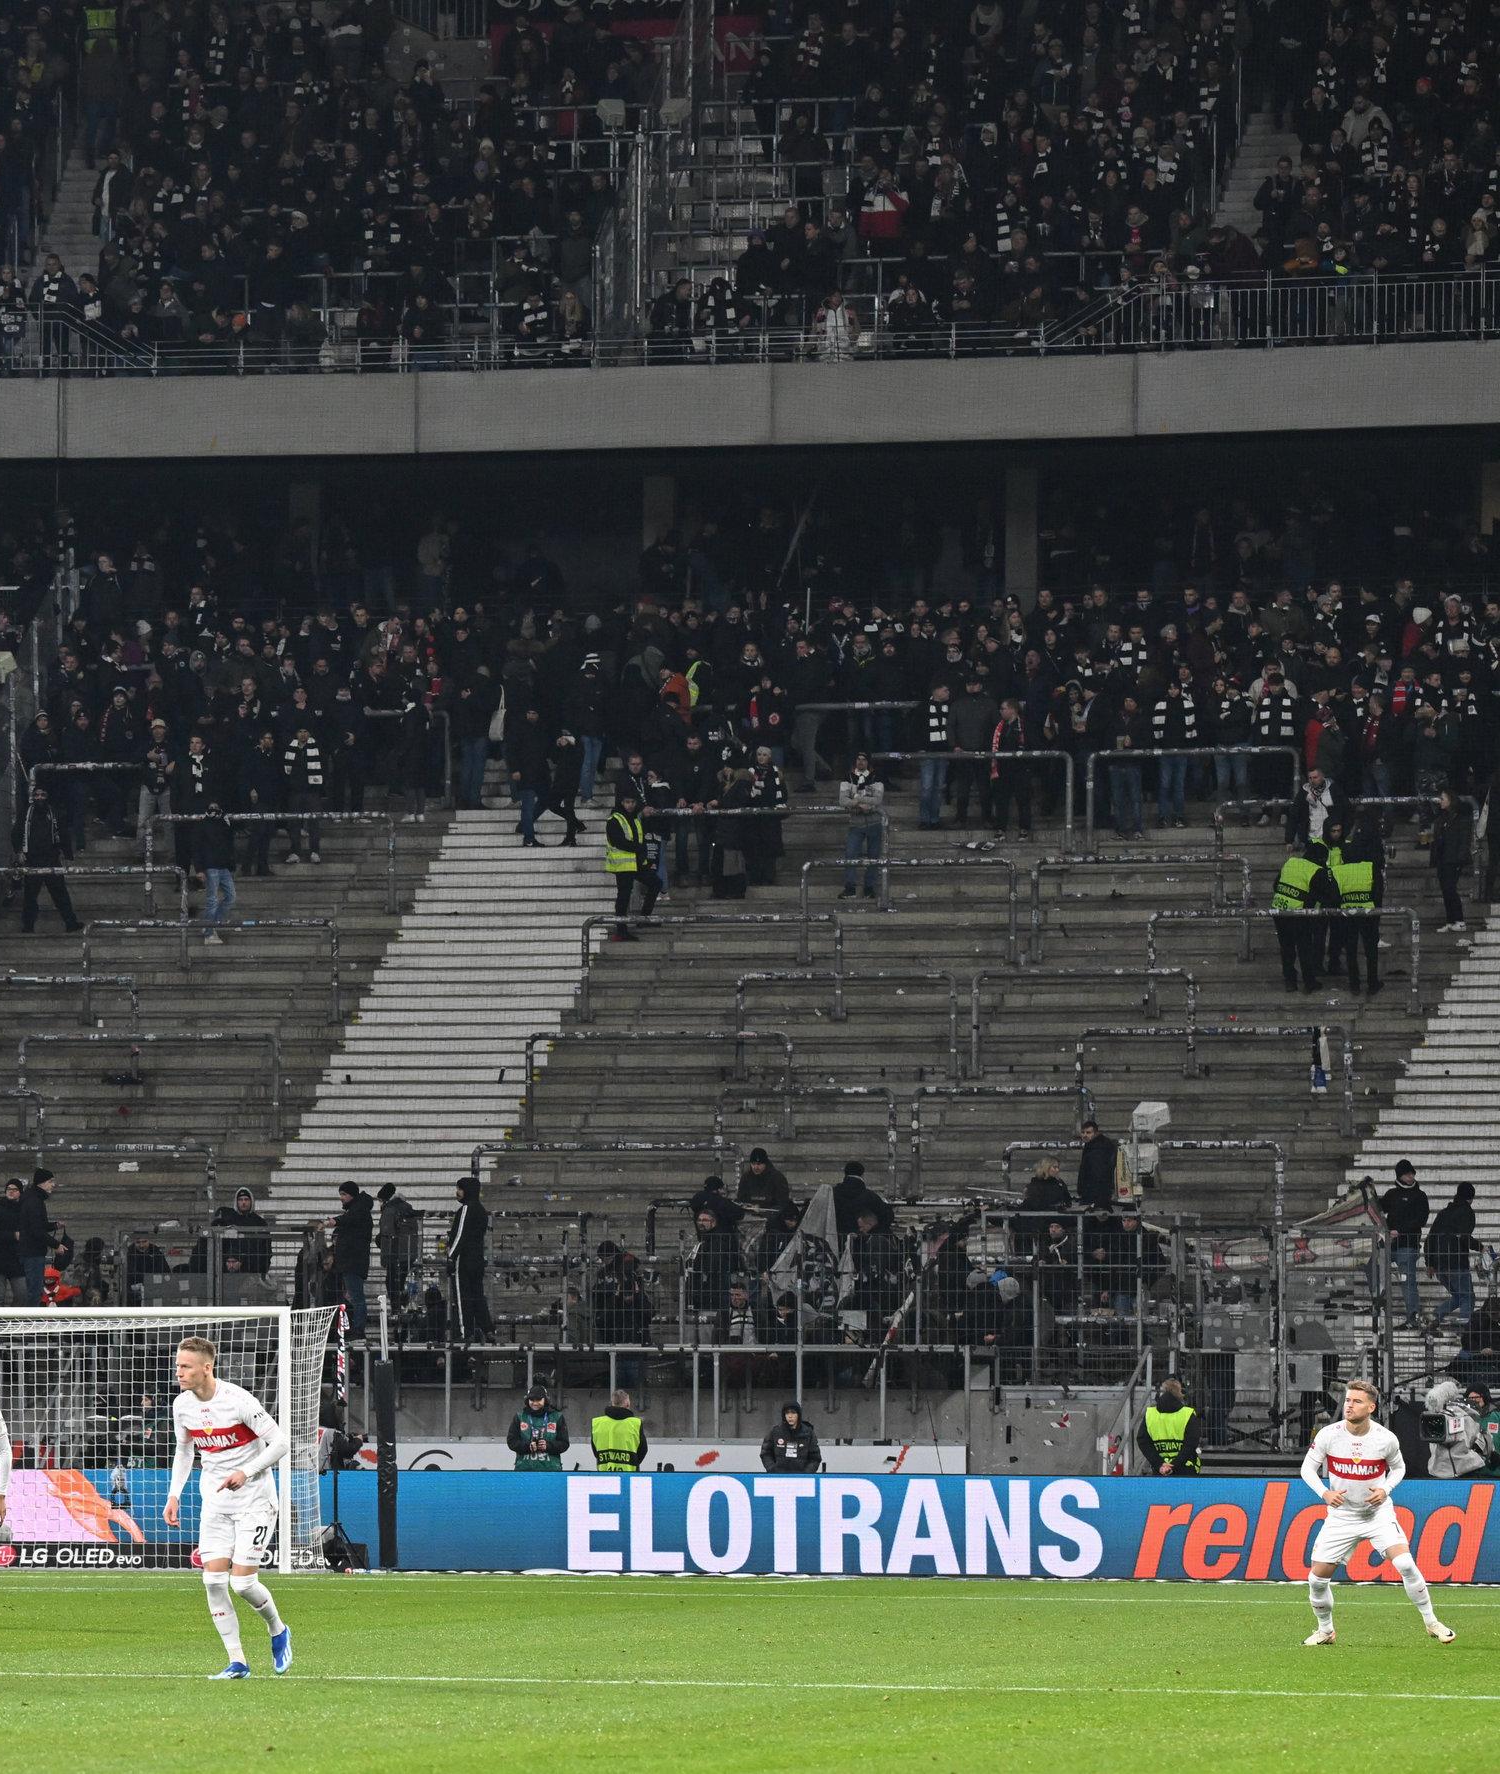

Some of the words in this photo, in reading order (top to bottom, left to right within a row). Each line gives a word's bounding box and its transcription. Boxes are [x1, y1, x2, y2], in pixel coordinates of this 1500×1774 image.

[1332, 1461, 1380, 1476] WINAMAX
[253, 1525, 268, 1546] 21
[567, 1475, 1104, 1577] ELOTRANS
[20, 1547, 49, 1564] LG
[56, 1547, 115, 1564] OLED
[116, 1555, 142, 1566] evo
